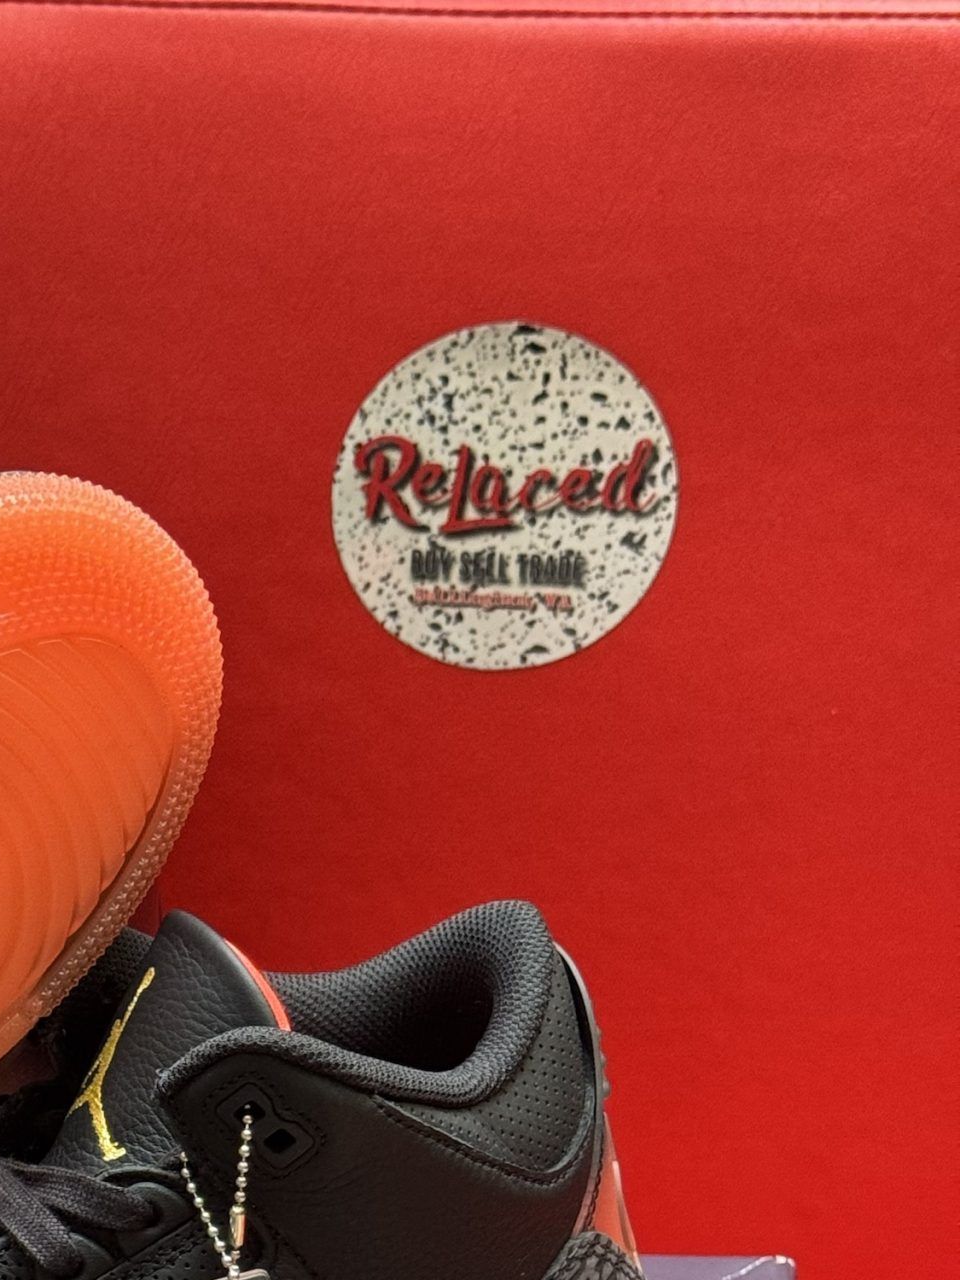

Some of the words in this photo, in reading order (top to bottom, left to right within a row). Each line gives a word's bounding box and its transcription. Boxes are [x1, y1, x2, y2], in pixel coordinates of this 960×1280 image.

[353, 434, 657, 533] ReLaced
[411, 549, 451, 583] BUY
[459, 549, 509, 584] SELL
[517, 552, 587, 587] TRADE
